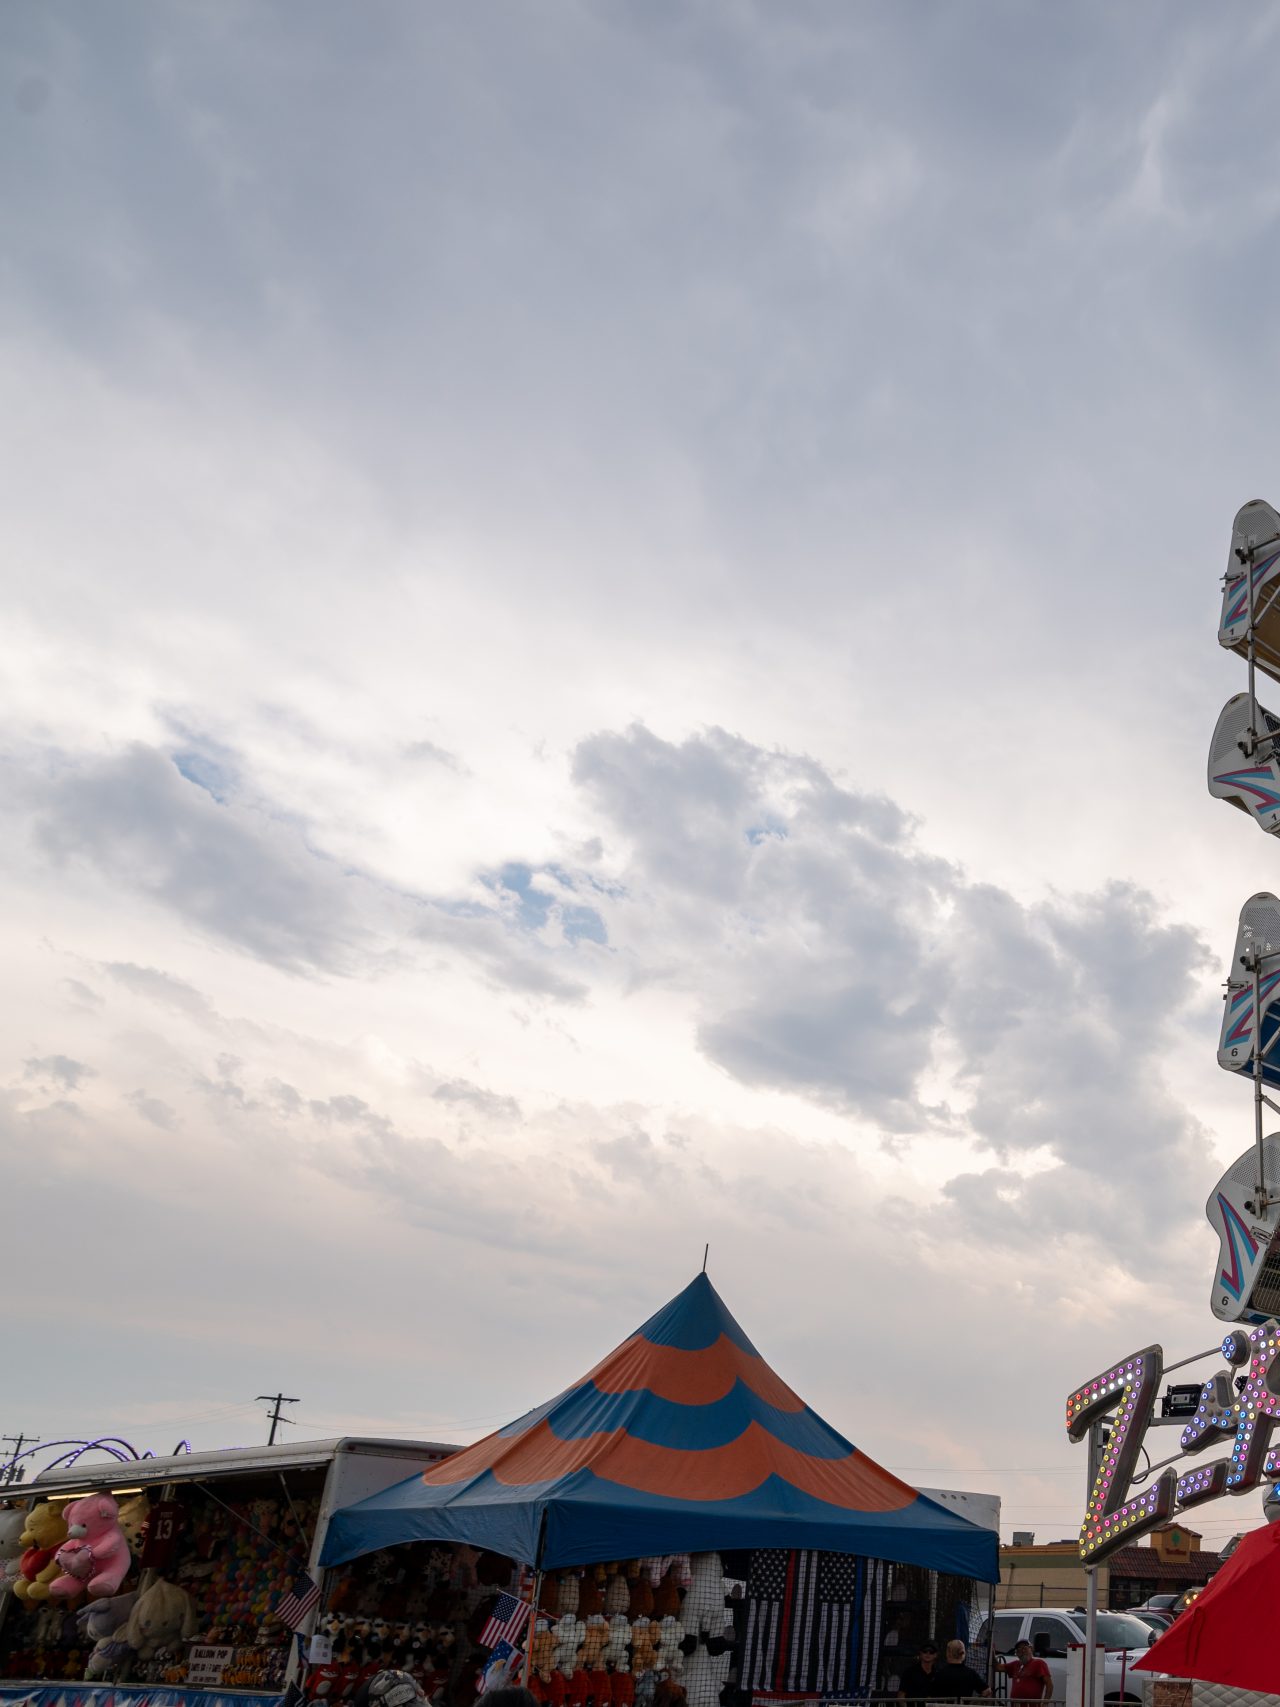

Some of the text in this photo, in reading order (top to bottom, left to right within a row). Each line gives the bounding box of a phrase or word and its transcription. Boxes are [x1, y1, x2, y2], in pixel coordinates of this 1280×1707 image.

[1231, 1047, 1239, 1057] 6
[1221, 1295, 1230, 1306] 6
[154, 1519, 174, 1540] 13
[216, 1649, 228, 1659] POP
